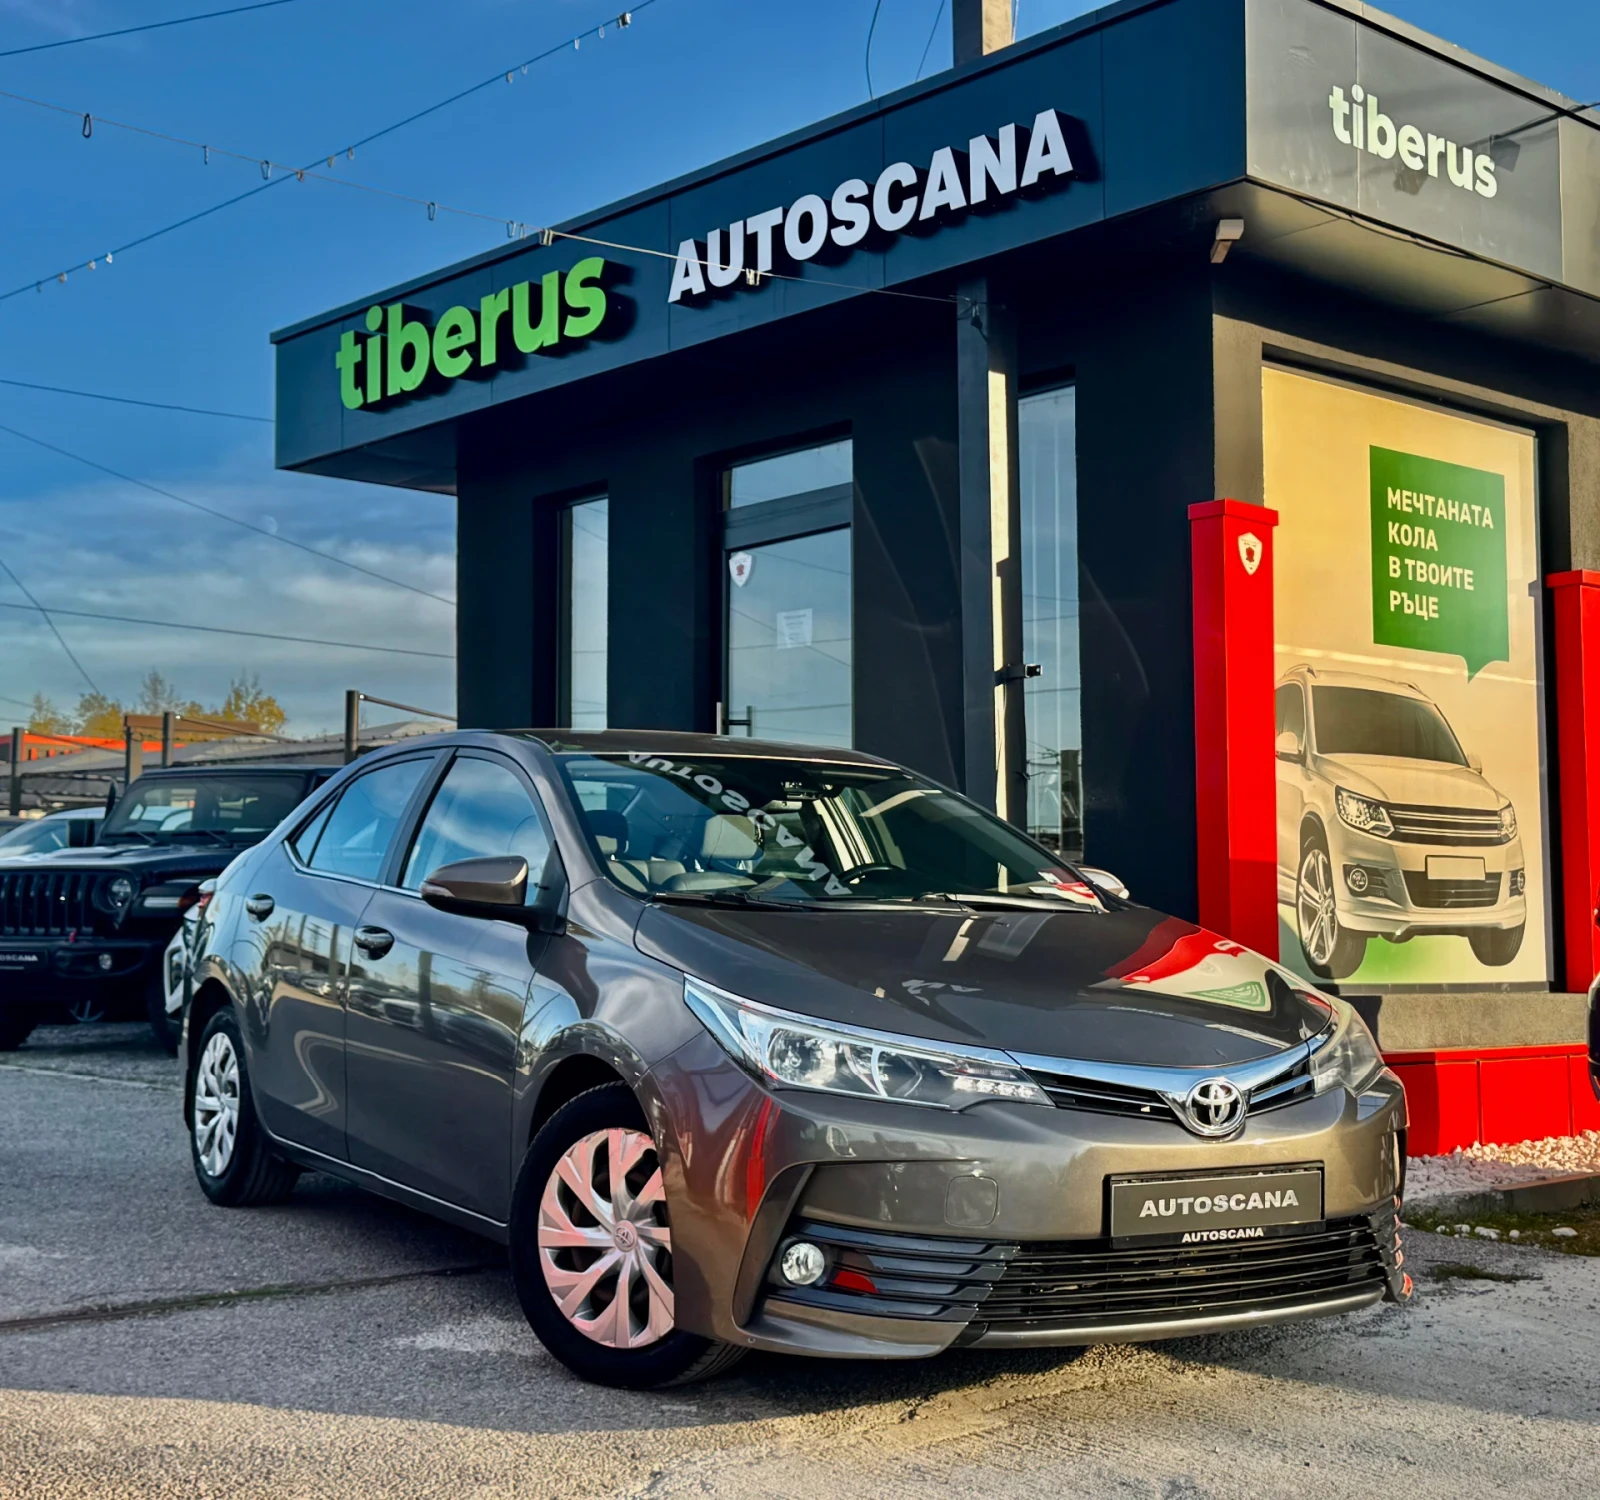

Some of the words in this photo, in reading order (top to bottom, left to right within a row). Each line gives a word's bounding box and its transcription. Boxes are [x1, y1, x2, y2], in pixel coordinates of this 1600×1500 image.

[1328, 83, 1498, 198] tiberus
[667, 108, 1073, 304] AUTOSCANA
[335, 256, 606, 410] tiberus
[1387, 486, 1494, 529] МЕЧТАНАТА
[1387, 521, 1438, 552] КОЛА
[1388, 555, 1401, 578] В
[1404, 558, 1475, 591] ТВОИТЕ
[1389, 590, 1439, 621] РЪЦЕ
[1138, 1189, 1299, 1218] AUTOSCANA
[1181, 1227, 1264, 1244] AUTOSCANA
